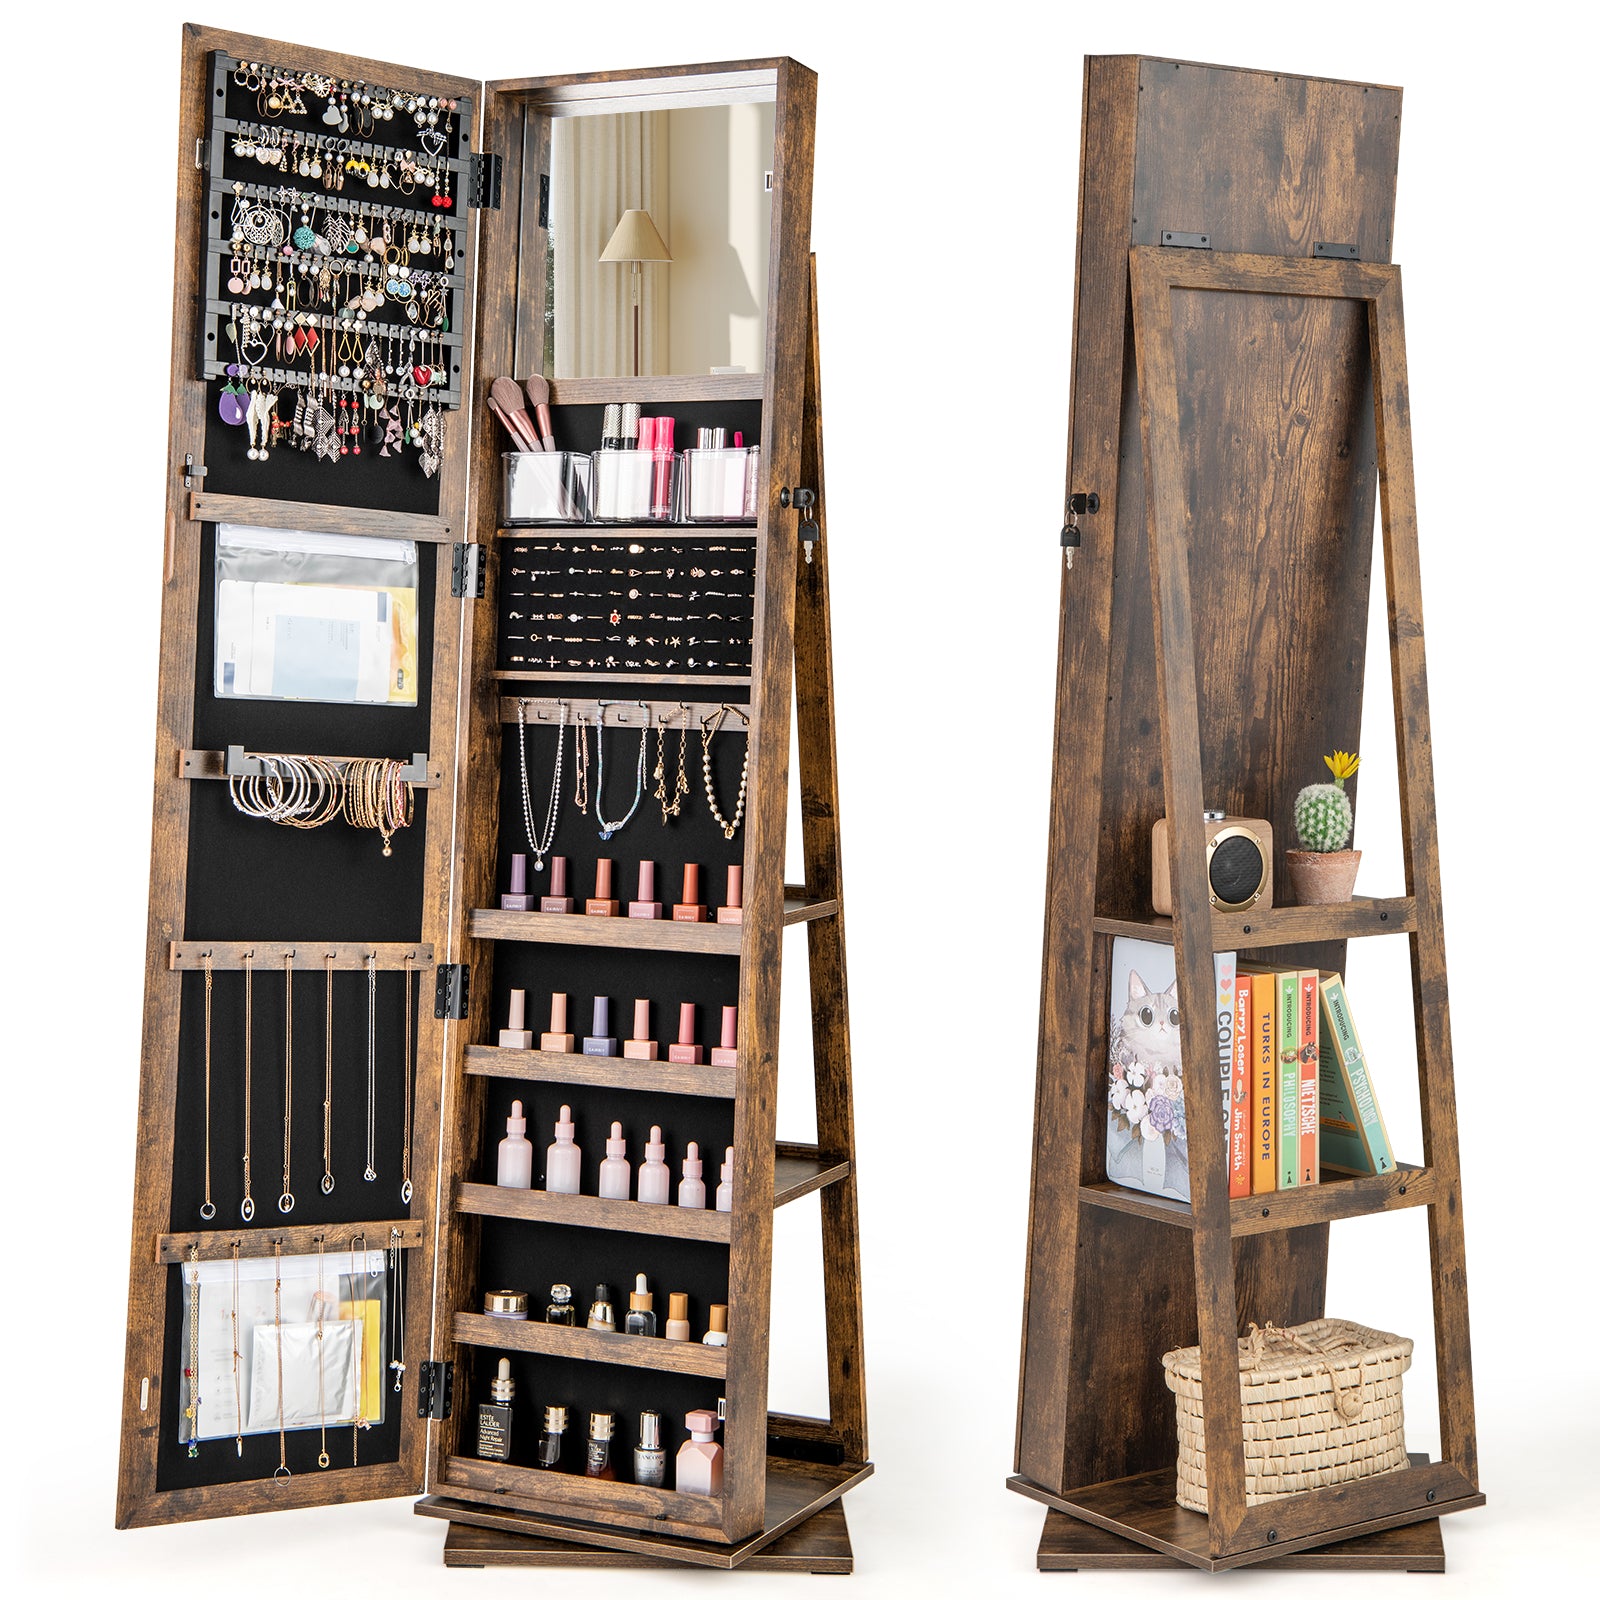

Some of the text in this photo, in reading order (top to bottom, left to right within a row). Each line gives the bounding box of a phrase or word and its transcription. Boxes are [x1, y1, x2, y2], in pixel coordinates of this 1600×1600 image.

[1236, 989, 1249, 1075] Barry Loser
[1333, 1000, 1349, 1040] INTRODUCING
[1262, 1012, 1271, 1160] TURKS IN EUROPE
[1283, 1072, 1296, 1137] PHILOSOPHY
[1301, 1079, 1316, 1136] NIETZSCHE
[1350, 1067, 1378, 1127] PSYCHOLOGY
[1234, 1108, 1243, 1171] Jim Smith
